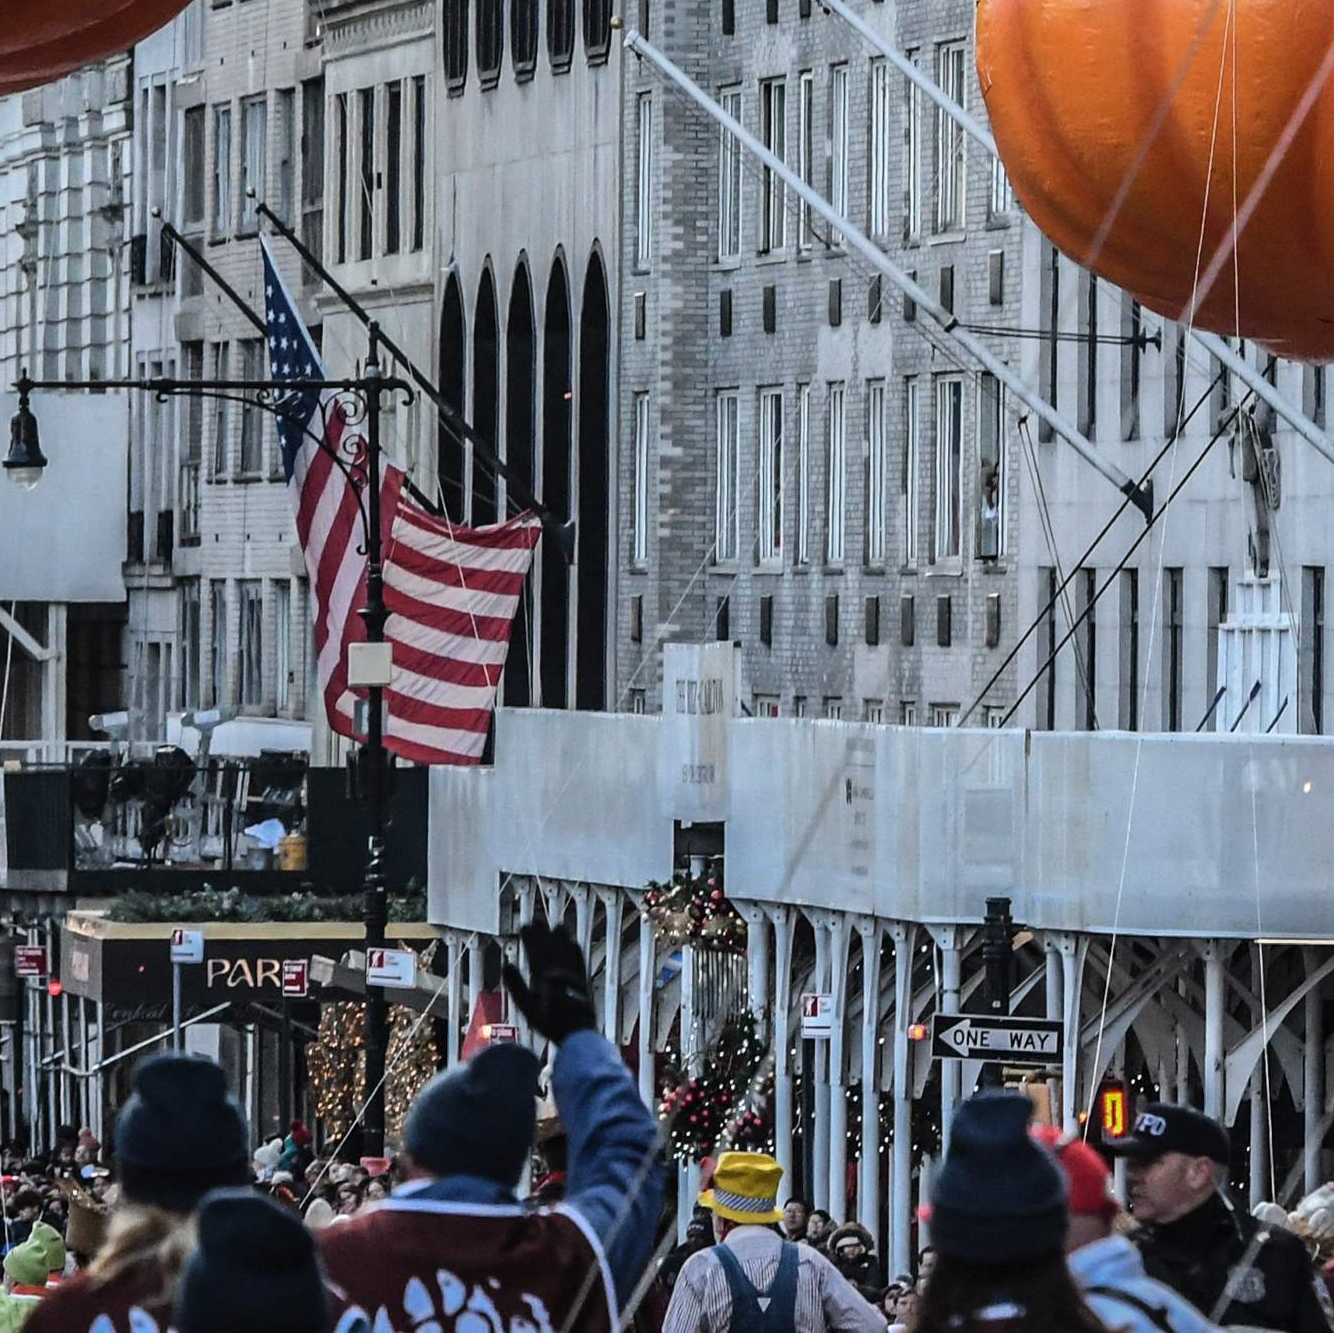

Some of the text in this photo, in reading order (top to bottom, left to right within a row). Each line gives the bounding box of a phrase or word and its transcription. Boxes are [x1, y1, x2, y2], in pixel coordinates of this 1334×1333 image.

[207, 958, 309, 988] PAR
[953, 1028, 1050, 1051] ONE WAY
